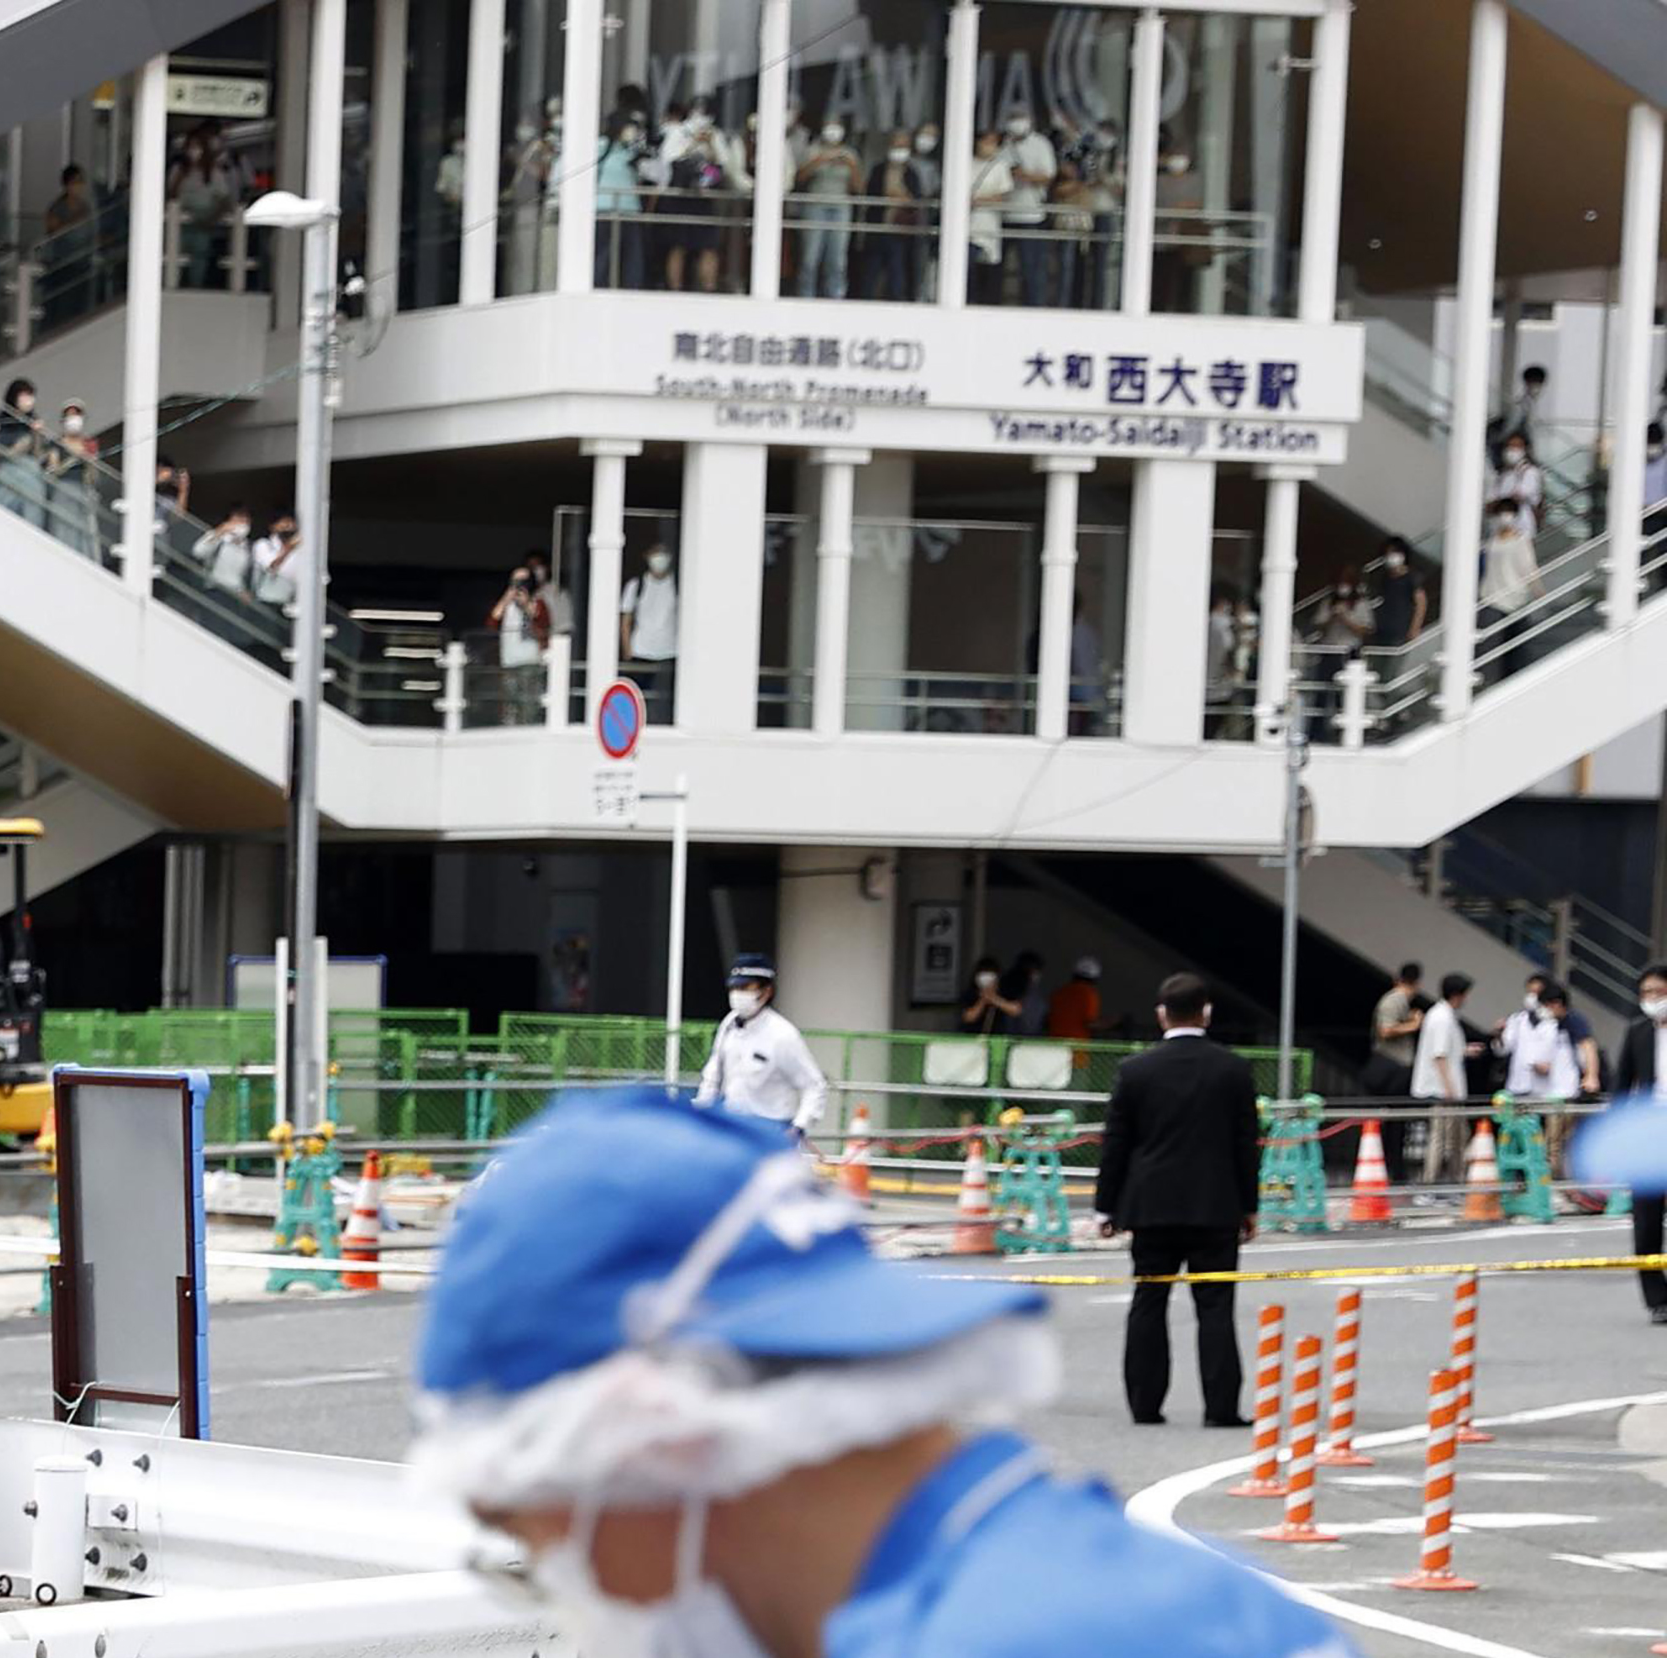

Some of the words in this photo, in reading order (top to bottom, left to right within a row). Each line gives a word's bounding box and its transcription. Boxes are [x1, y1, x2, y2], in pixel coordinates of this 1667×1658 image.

[805, 381, 929, 404] Promenade
[1023, 351, 1300, 411] 大和西大寺駅
[989, 413, 1207, 456] Yamato-Saidaiji
[1218, 421, 1320, 453] Station
